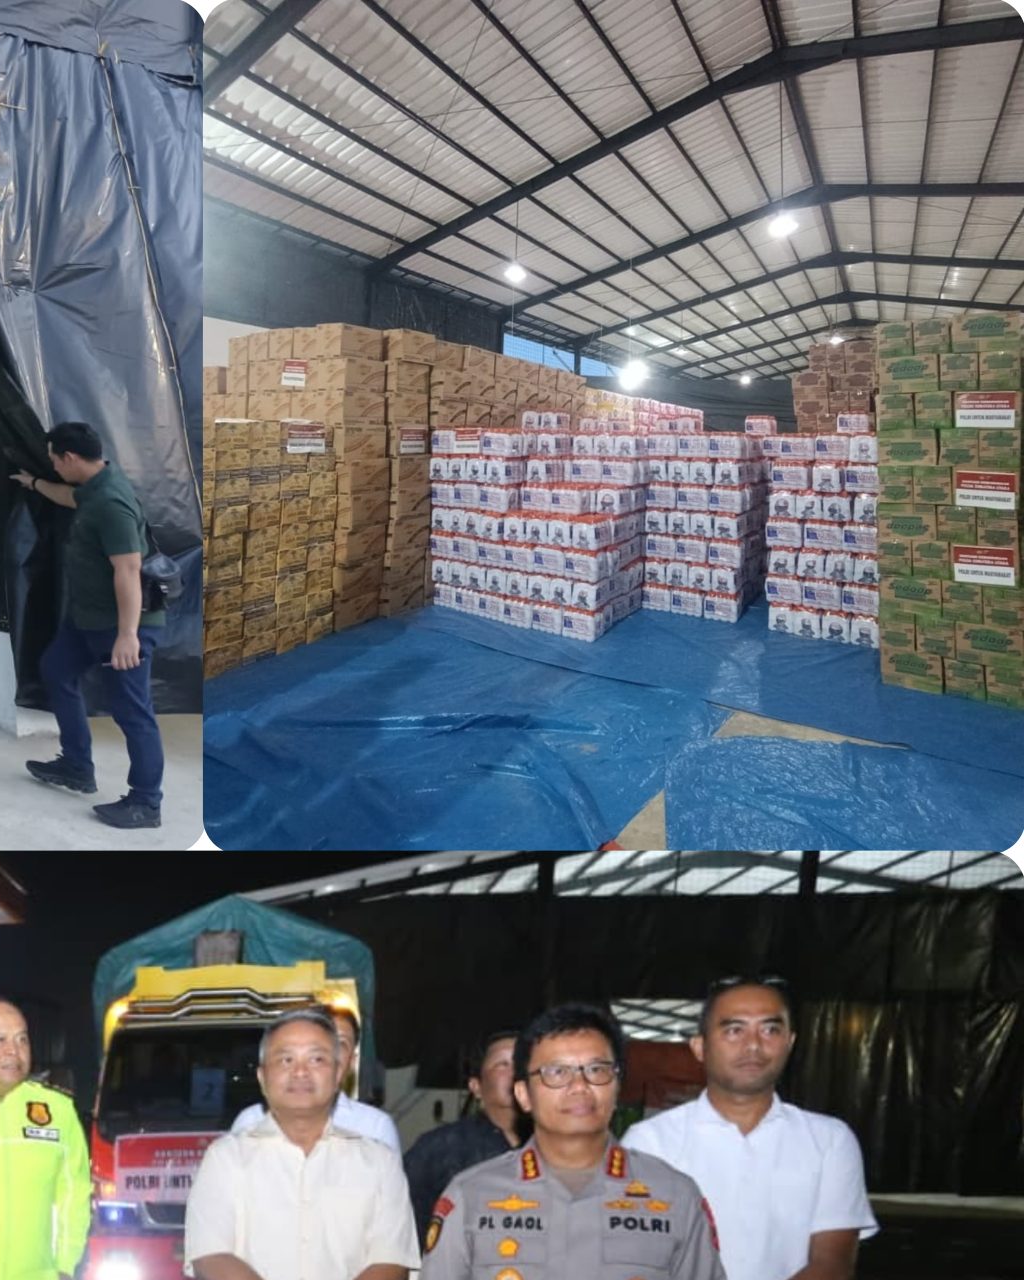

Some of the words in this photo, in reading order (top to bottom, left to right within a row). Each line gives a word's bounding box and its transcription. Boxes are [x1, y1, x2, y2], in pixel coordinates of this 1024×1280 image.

[479, 1216, 495, 1230] PL
[502, 1215, 544, 1231] GAOL
[609, 1216, 670, 1233] POLRI
